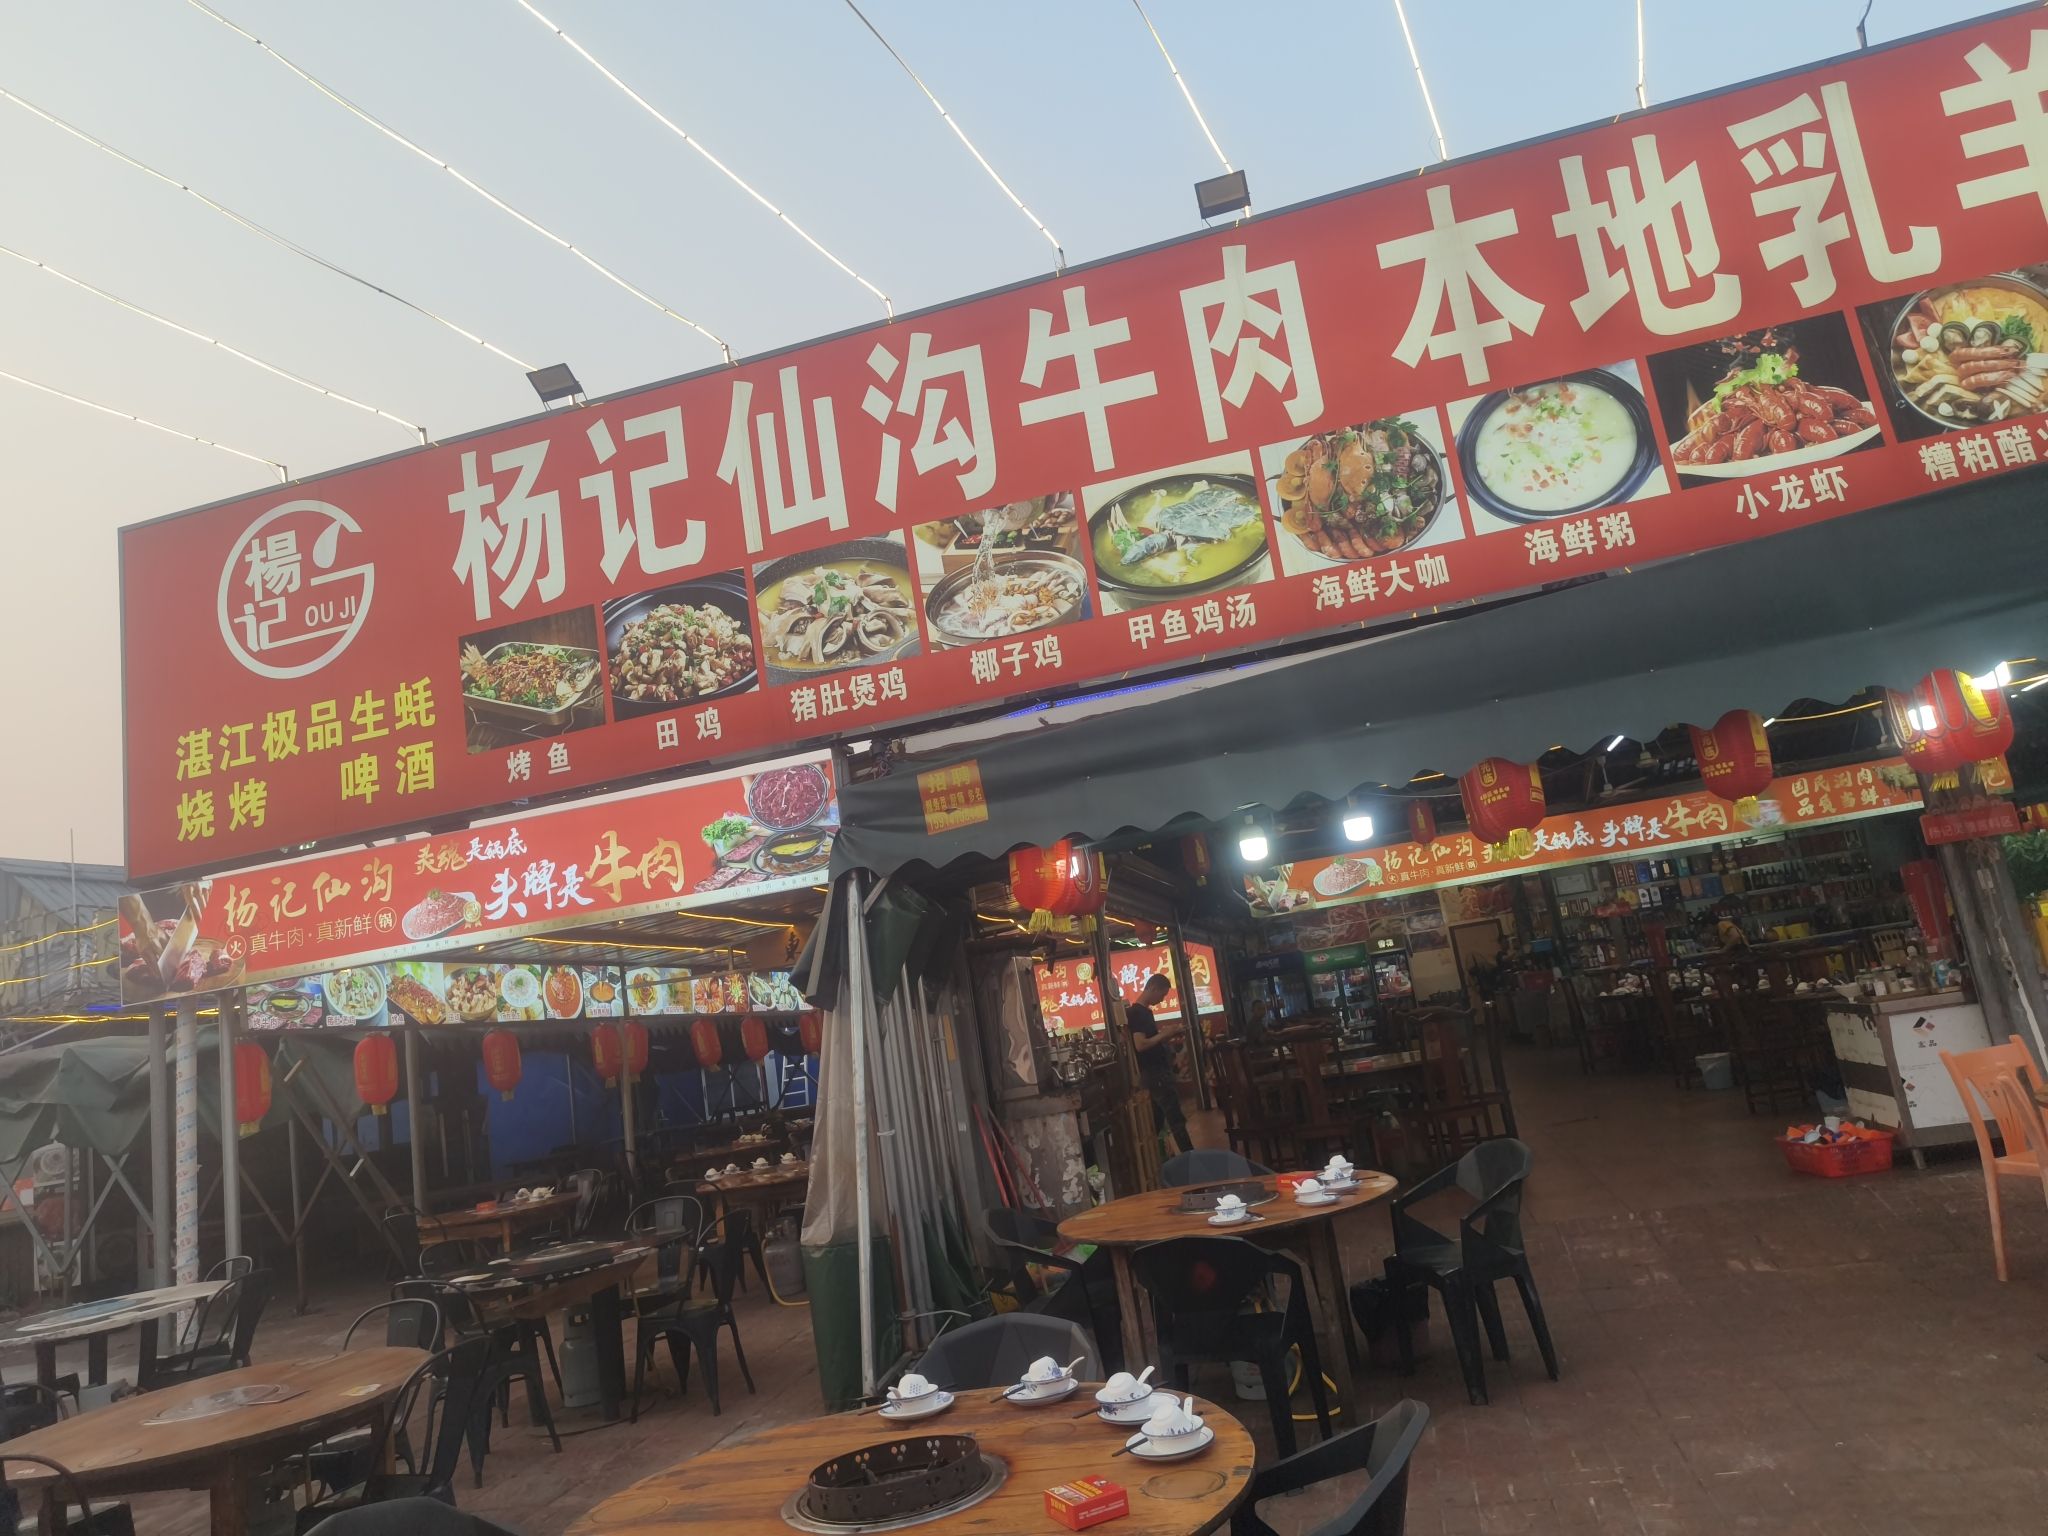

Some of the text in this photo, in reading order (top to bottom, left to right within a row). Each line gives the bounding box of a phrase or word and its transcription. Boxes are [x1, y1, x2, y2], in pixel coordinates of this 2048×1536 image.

[448, 245, 1324, 621] 杨记仙沟牛肉
[1736, 465, 1848, 520] 小龙虾
[1524, 510, 1636, 566] 海鲜粥
[1312, 553, 1450, 611] 海鲜大咖
[305, 601, 333, 627] OU
[1128, 593, 1257, 650] 甲鱼鸡汤
[970, 634, 1063, 685] 椰子鸡
[790, 667, 908, 723] 猪肚煲鸡
[176, 676, 435, 781] 湛江极品生蚝
[656, 706, 722, 750] 田鸡
[506, 742, 571, 783] 烤鱼
[177, 741, 435, 842] 烧烤 啤酒
[1382, 835, 1473, 872] 杨记仙沟
[224, 856, 393, 932] 杨记仙沟
